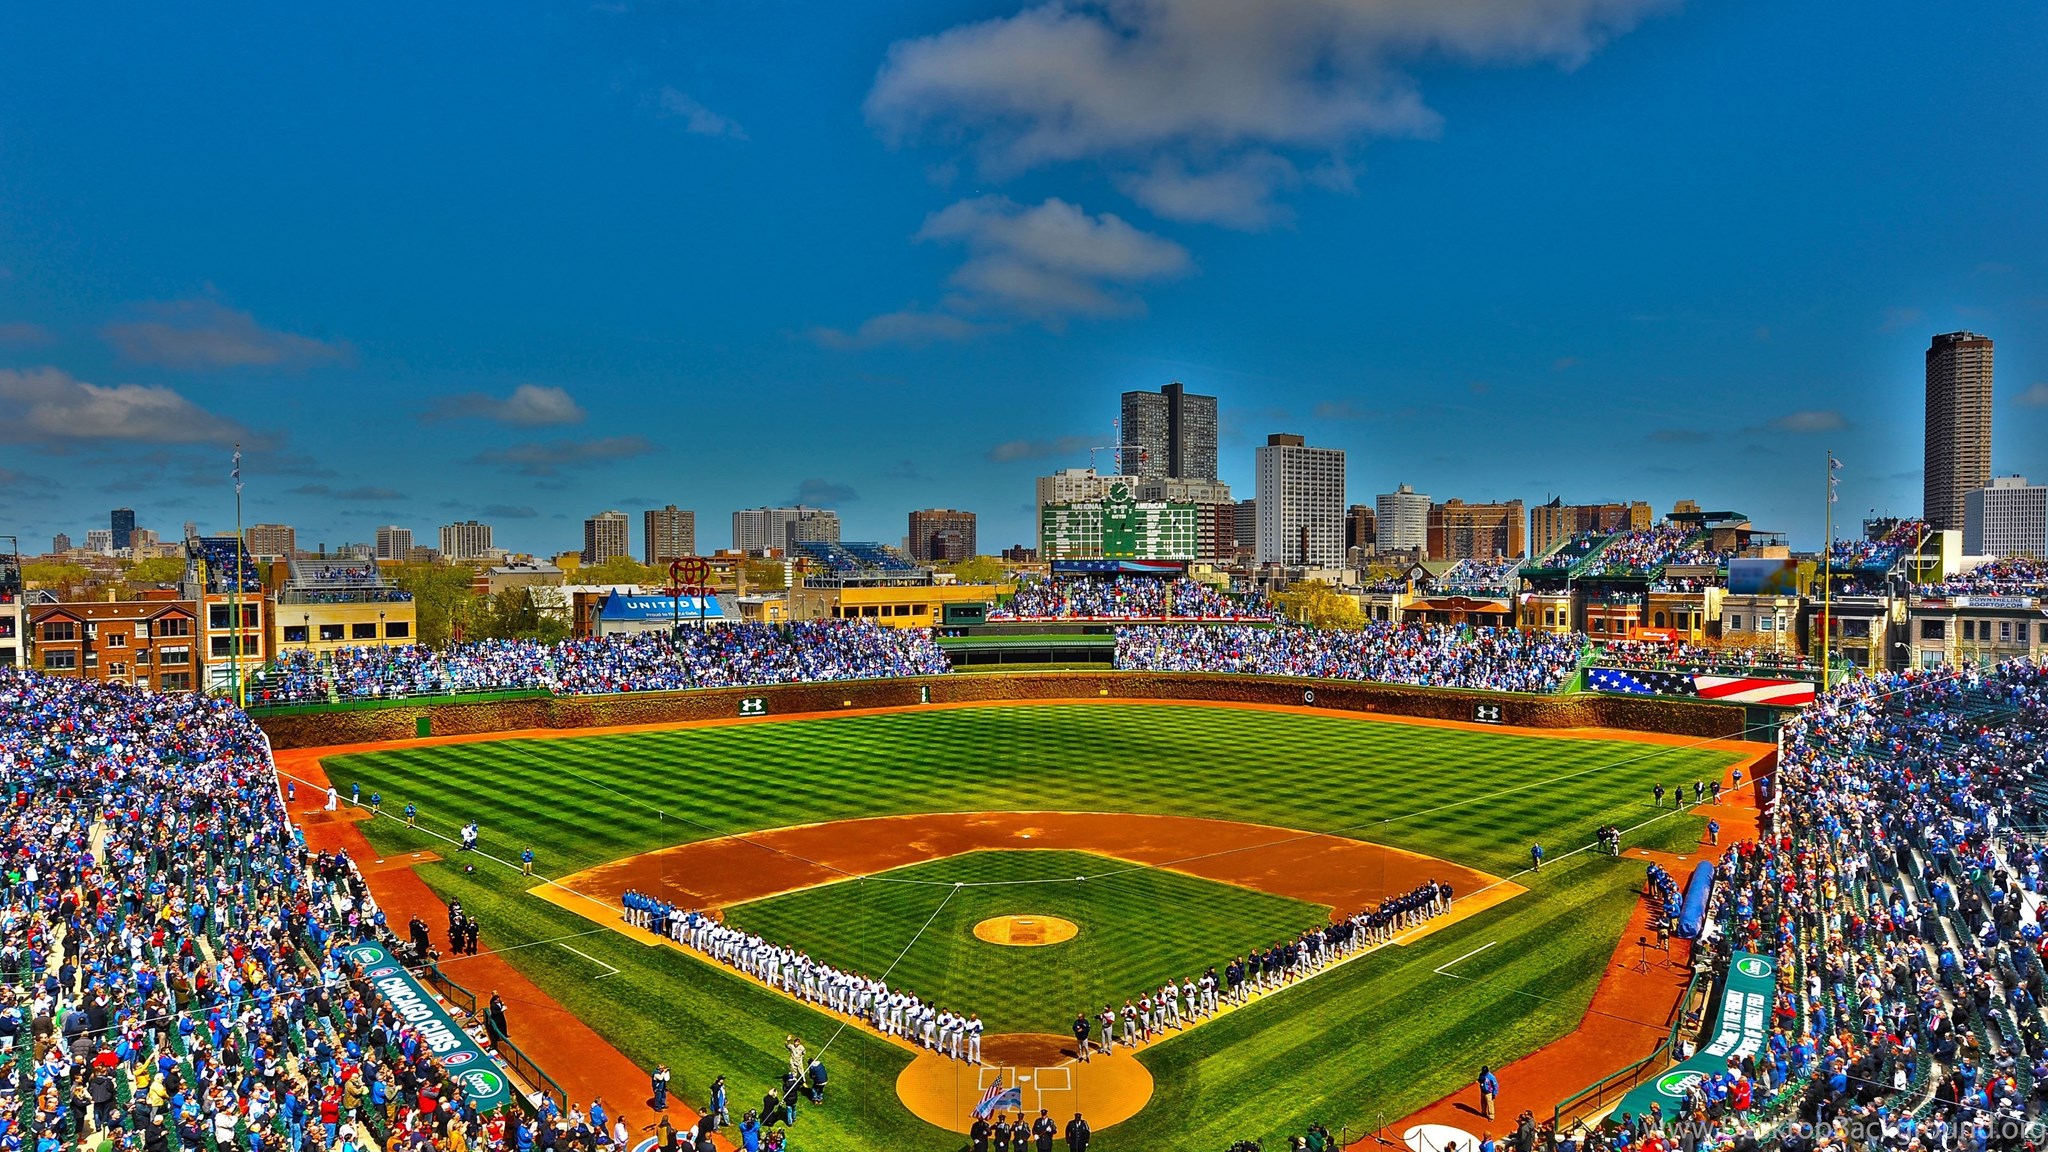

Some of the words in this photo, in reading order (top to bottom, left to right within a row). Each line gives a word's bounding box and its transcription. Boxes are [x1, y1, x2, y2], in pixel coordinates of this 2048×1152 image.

[663, 587, 717, 598] TOYOTA
[627, 601, 690, 609] UNITED
[377, 977, 433, 1021] CHICAGO
[414, 1019, 461, 1053] CUBS
[465, 1073, 492, 1095] Scotts
